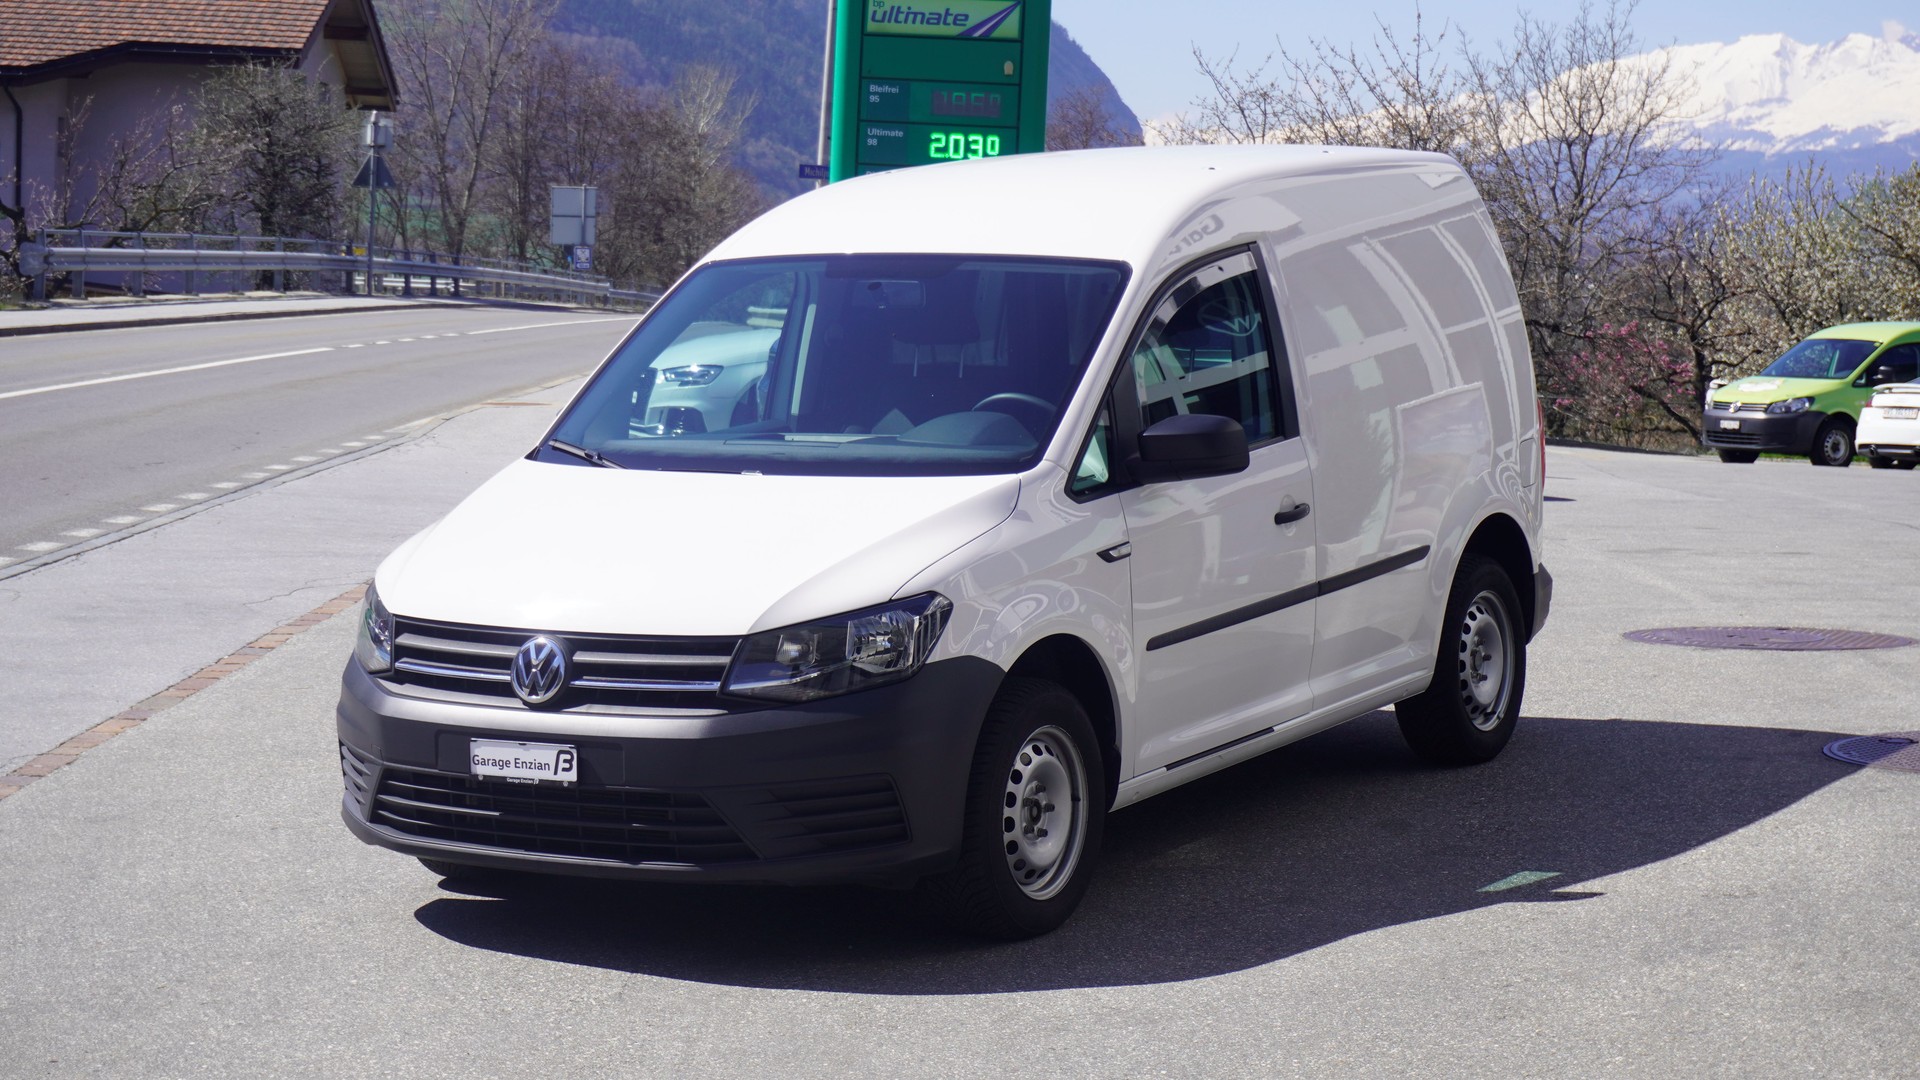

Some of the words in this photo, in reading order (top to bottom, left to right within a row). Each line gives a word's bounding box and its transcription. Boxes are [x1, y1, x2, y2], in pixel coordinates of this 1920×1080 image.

[871, 5, 970, 27] ultimate
[869, 84, 899, 94] Bleifrei
[869, 94, 880, 103] 95
[867, 127, 904, 138] Ultimate
[867, 138, 878, 146] 98
[472, 754, 511, 770] Garage
[514, 758, 551, 771] Enzian
